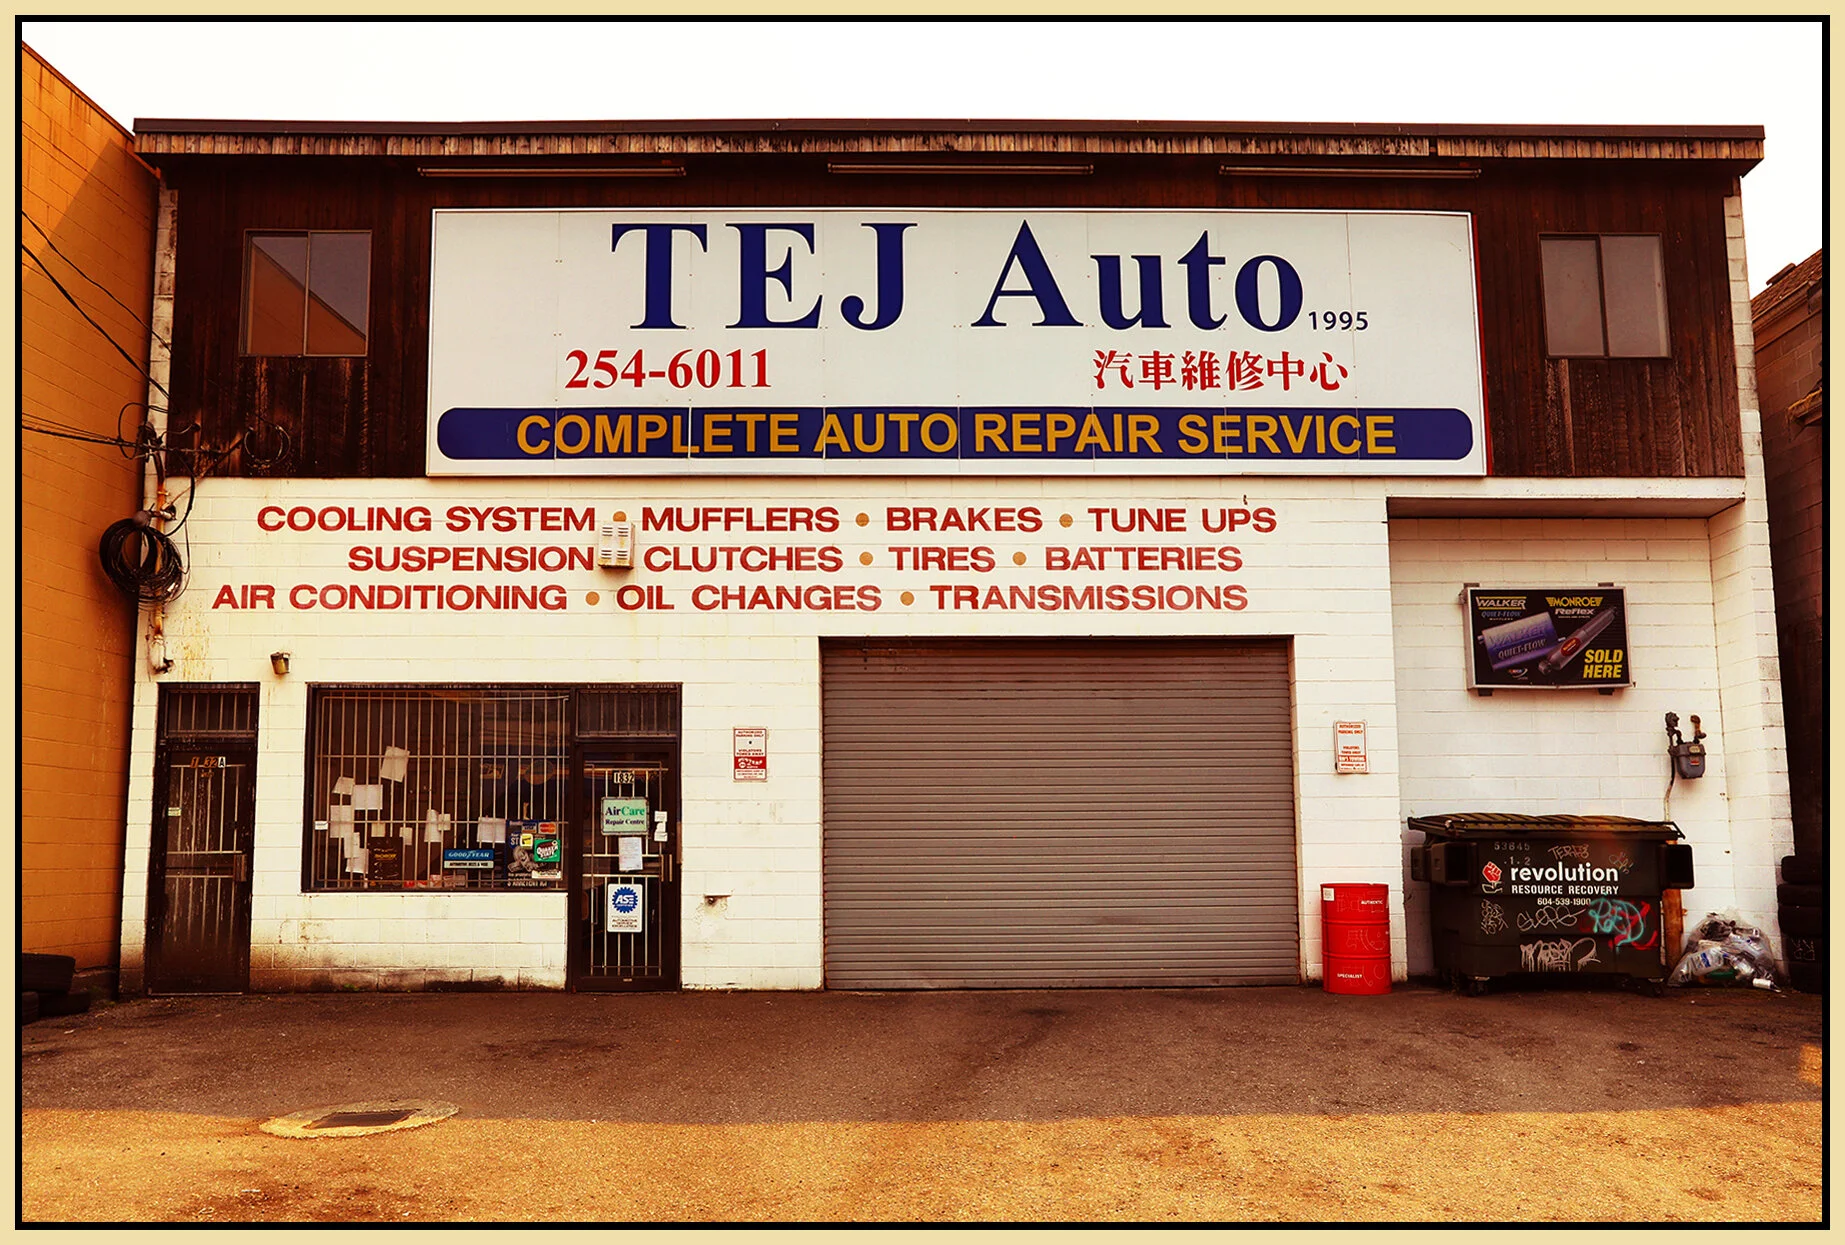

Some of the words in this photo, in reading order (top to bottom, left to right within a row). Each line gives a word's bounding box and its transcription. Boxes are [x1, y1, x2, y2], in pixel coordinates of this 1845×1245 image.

[611, 223, 918, 331] TEJ
[971, 219, 1304, 332] Auto
[1308, 311, 1369, 331] 1995
[564, 348, 772, 389] 254-6011
[1092, 350, 1349, 391] 汽車維修中心
[516, 414, 800, 455] COMPLETE
[813, 412, 958, 453] AUTO
[974, 413, 1163, 453] REPAIR
[1177, 414, 1396, 455] SERVICE
[257, 506, 432, 532] COOLING
[446, 506, 595, 532] SYSTEM
[643, 506, 840, 533] MUFFLERS
[887, 506, 1043, 533] BRAKES
[1088, 507, 1187, 533] TUNE
[1202, 506, 1278, 534] UPS
[348, 545, 594, 572] SUSPENSION
[644, 545, 844, 572] CLUTCHES
[889, 545, 996, 572] TIRES
[1046, 545, 1243, 572] BATTERIES
[212, 584, 275, 610] AIR
[289, 584, 567, 610] CONDITIONING
[617, 584, 674, 610] OIL
[692, 584, 882, 611] CHANGES
[930, 584, 1249, 610] TRANSMISSIONS
[1475, 596, 1527, 609] WALKER
[1551, 596, 1598, 607] MONROE
[1584, 649, 1624, 664] SOLD
[1583, 664, 1622, 679] HERE
[614, 772, 634, 783] 1832
[448, 850, 490, 859] GOODYEAR
[1511, 861, 1619, 882] revolution
[615, 895, 635, 904] ASE
[1511, 885, 1563, 895] RESOURCE
[1568, 885, 1619, 895] RECOVERY
